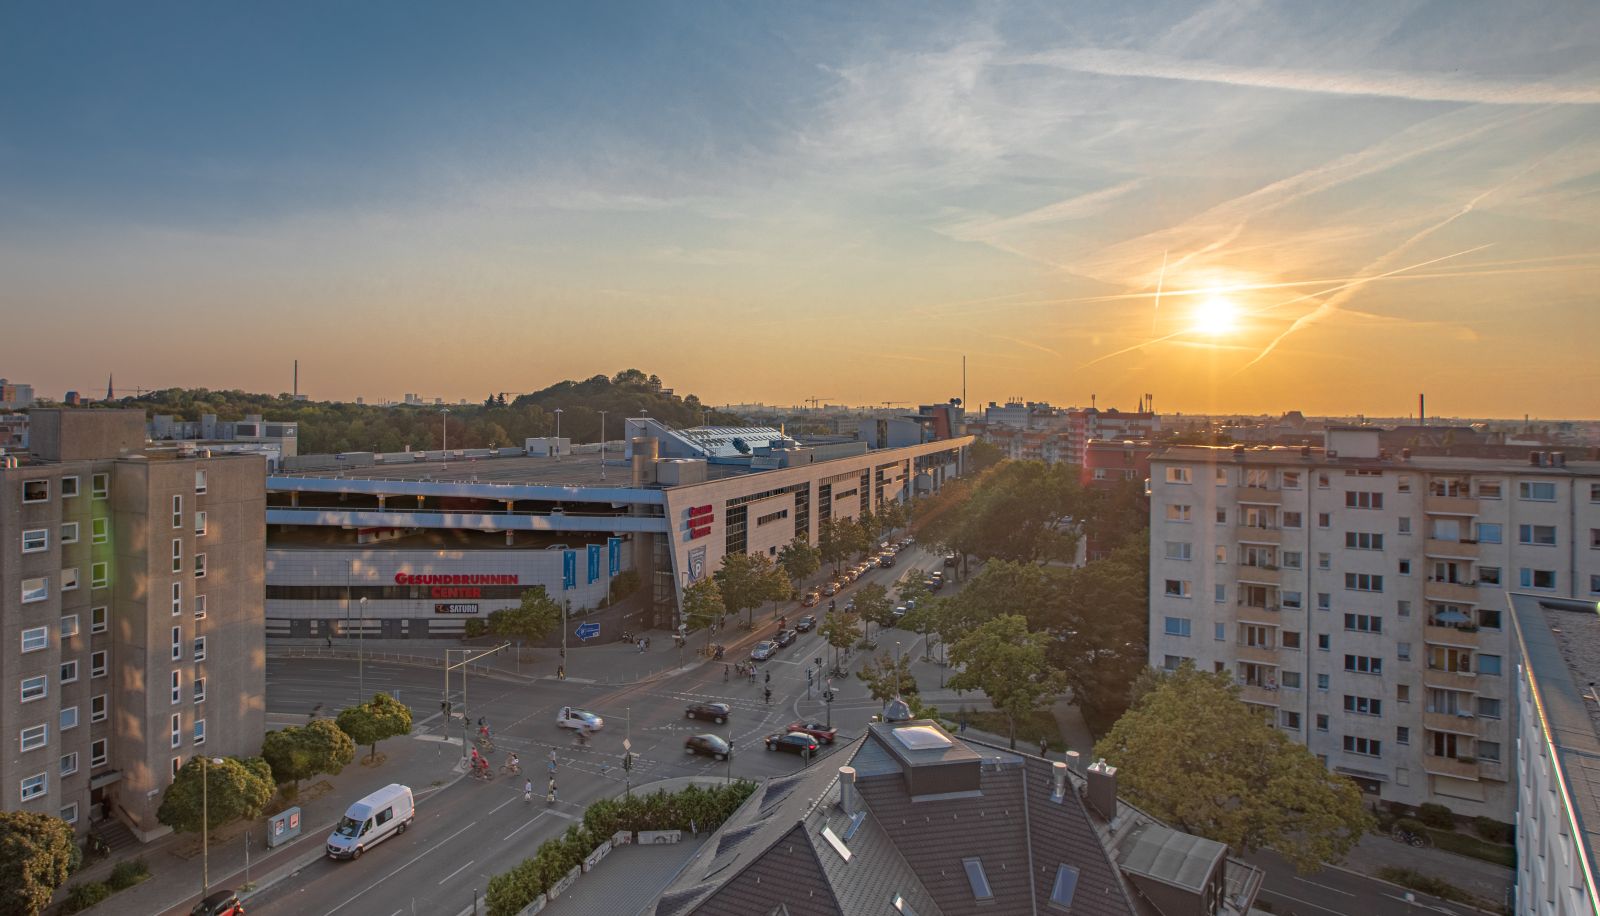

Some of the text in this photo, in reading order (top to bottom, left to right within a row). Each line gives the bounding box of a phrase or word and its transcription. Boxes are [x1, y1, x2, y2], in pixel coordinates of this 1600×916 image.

[395, 573, 518, 584] GESUNDBRUNNEN
[432, 587, 480, 598] CENTER
[449, 604, 477, 613] SATURN
